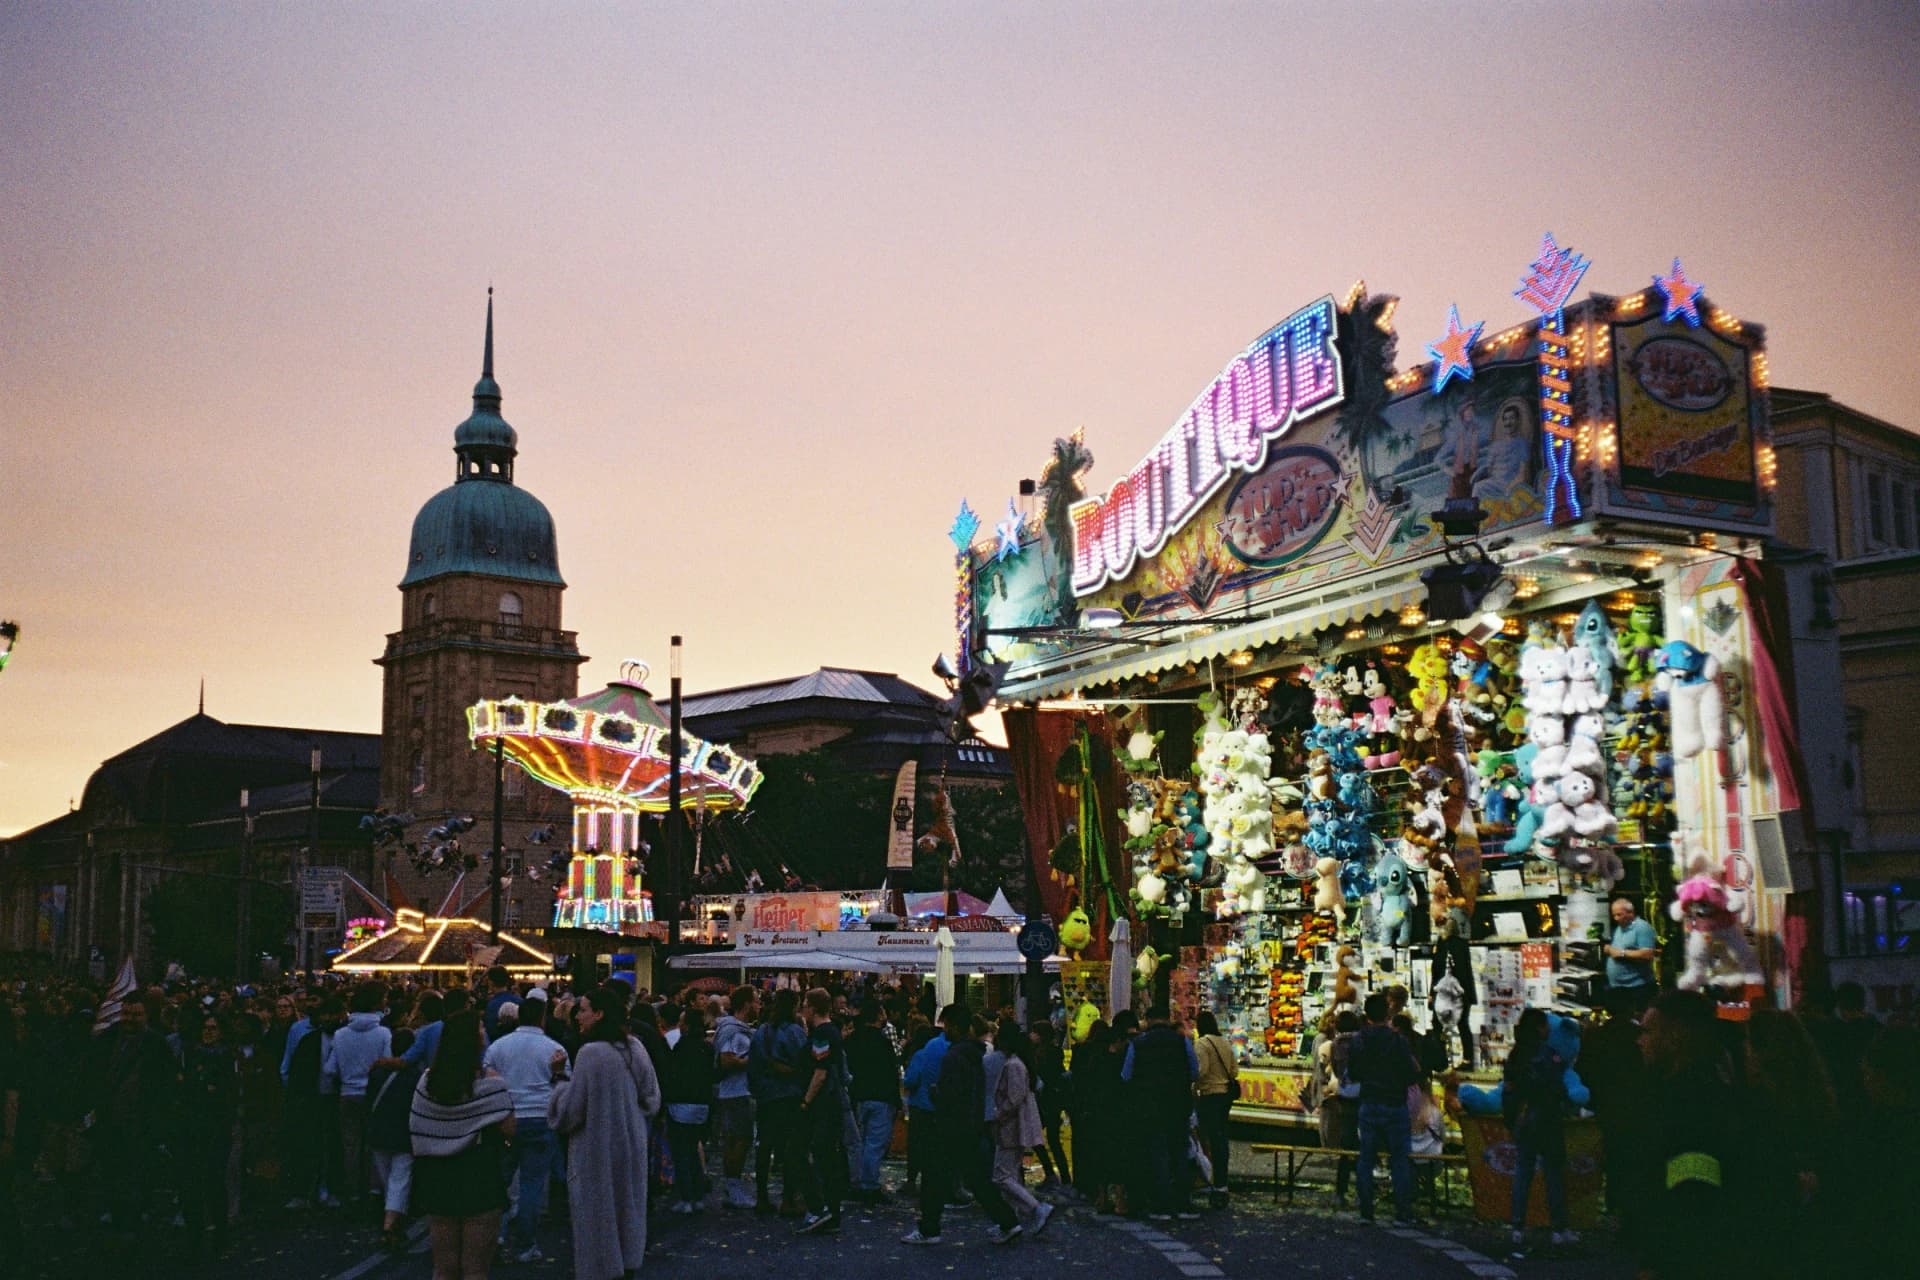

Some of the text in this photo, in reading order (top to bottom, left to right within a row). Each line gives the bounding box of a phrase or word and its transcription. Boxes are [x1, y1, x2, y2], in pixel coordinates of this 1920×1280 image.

[1071, 297, 1337, 590] BOUTIQUE
[753, 903, 806, 929] Heiner
[771, 933, 808, 945] Bratwurst
[878, 935, 929, 945] Hausmann's
